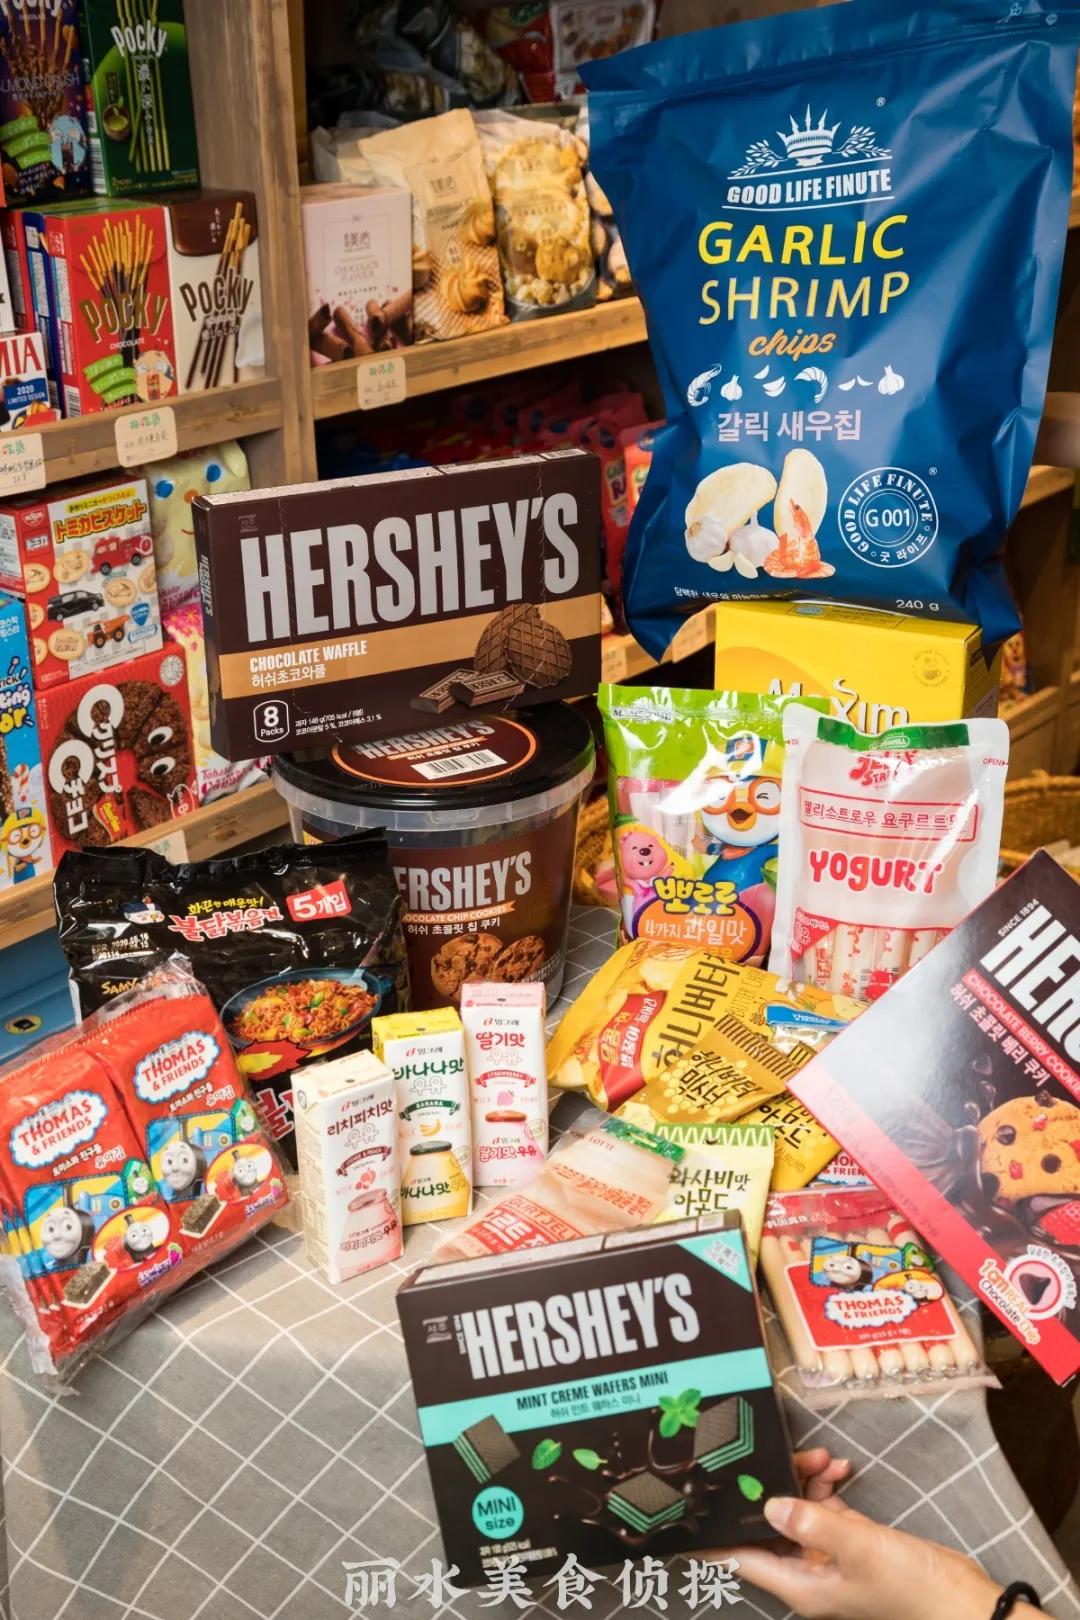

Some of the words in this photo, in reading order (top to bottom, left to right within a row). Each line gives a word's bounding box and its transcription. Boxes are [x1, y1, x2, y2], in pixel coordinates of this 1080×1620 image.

[110, 20, 168, 58] POCKY
[727, 183, 782, 205] GOOD
[785, 178, 822, 203] LIFE
[825, 168, 892, 198] FINUTE
[698, 215, 908, 265] GARLIC
[180, 268, 254, 322] POCKY
[699, 271, 910, 325] SHRIMP
[748, 328, 837, 362] chips
[17, 385, 35, 395] 2020
[717, 411, 769, 442] 갈릭
[777, 410, 862, 441] 새우칩
[848, 474, 882, 506] LIFE
[886, 473, 933, 521] FINUTE
[54, 499, 147, 544] トミカビスケット
[844, 509, 869, 552] GOOD
[865, 508, 879, 527] G
[882, 508, 910, 527] 001
[880, 552, 890, 562] 굿
[896, 533, 928, 560] 라이프
[241, 492, 580, 642] HERSHEY'S
[199, 555, 213, 616] HERSHEY'S
[896, 599, 923, 610] 240
[929, 602, 939, 612] g
[250, 645, 319, 674] CHOCOLATE
[323, 640, 368, 661] WAFFLE
[252, 663, 326, 688] 허쉬초코와플
[260, 726, 285, 738] Packs
[264, 706, 279, 726] 8
[352, 720, 496, 759] HERSHEY'S
[983, 757, 1001, 766] OPEN
[394, 851, 532, 911] ERSHEY'S
[653, 876, 738, 916] 뽀로로
[293, 889, 348, 919] 5개입
[404, 913, 446, 922] OCOLATE
[447, 912, 469, 922] CHIP
[469, 906, 507, 919] COOKIES
[998, 914, 1021, 938] SINCE
[1020, 898, 1040, 918] 1894
[168, 906, 284, 941] 불닭볶음면
[408, 924, 428, 935] 허쉬
[432, 924, 464, 935] 초콜릿
[467, 921, 478, 933] 칩
[480, 917, 500, 930] 쿠키
[645, 917, 682, 939] 4가지
[684, 914, 748, 946] 과일맛
[101, 977, 138, 995] SAMY
[967, 974, 1021, 1030] CHOCOLATE
[1018, 1023, 1049, 1057] BERRY
[475, 1032, 526, 1051] 딸기맛
[950, 982, 977, 1011] 허쉬
[969, 1005, 1008, 1043] 초콜릿
[1001, 1035, 1029, 1066] 베리
[1023, 1058, 1052, 1088] 쿠키
[142, 1040, 206, 1083] THOMAS
[152, 1080, 160, 1091] &
[162, 1055, 205, 1086] FRIENDS
[392, 1057, 465, 1081] 바나나맛
[692, 1050, 763, 1098] 허니버터
[327, 1099, 393, 1136] 리치피치맛
[416, 1100, 443, 1109] BANANA
[18, 1098, 93, 1147] THOMAS
[31, 1144, 40, 1156] &
[42, 1116, 92, 1149] FRIENDS
[589, 1135, 615, 1151] LOTTE
[669, 1168, 751, 1192] 와사비맛
[834, 1295, 905, 1311] THOMAS
[843, 1312, 851, 1320] &
[854, 1307, 903, 1319] FRIENDS
[981, 1279, 1021, 1323] Chocolate
[460, 1273, 700, 1380] HERSHEY'S
[516, 1393, 548, 1411] MINT
[551, 1386, 589, 1405] CREME
[592, 1377, 637, 1398] WAFERS
[640, 1371, 669, 1390] MINI
[477, 1496, 516, 1517] MINI
[485, 1515, 515, 1531] size
